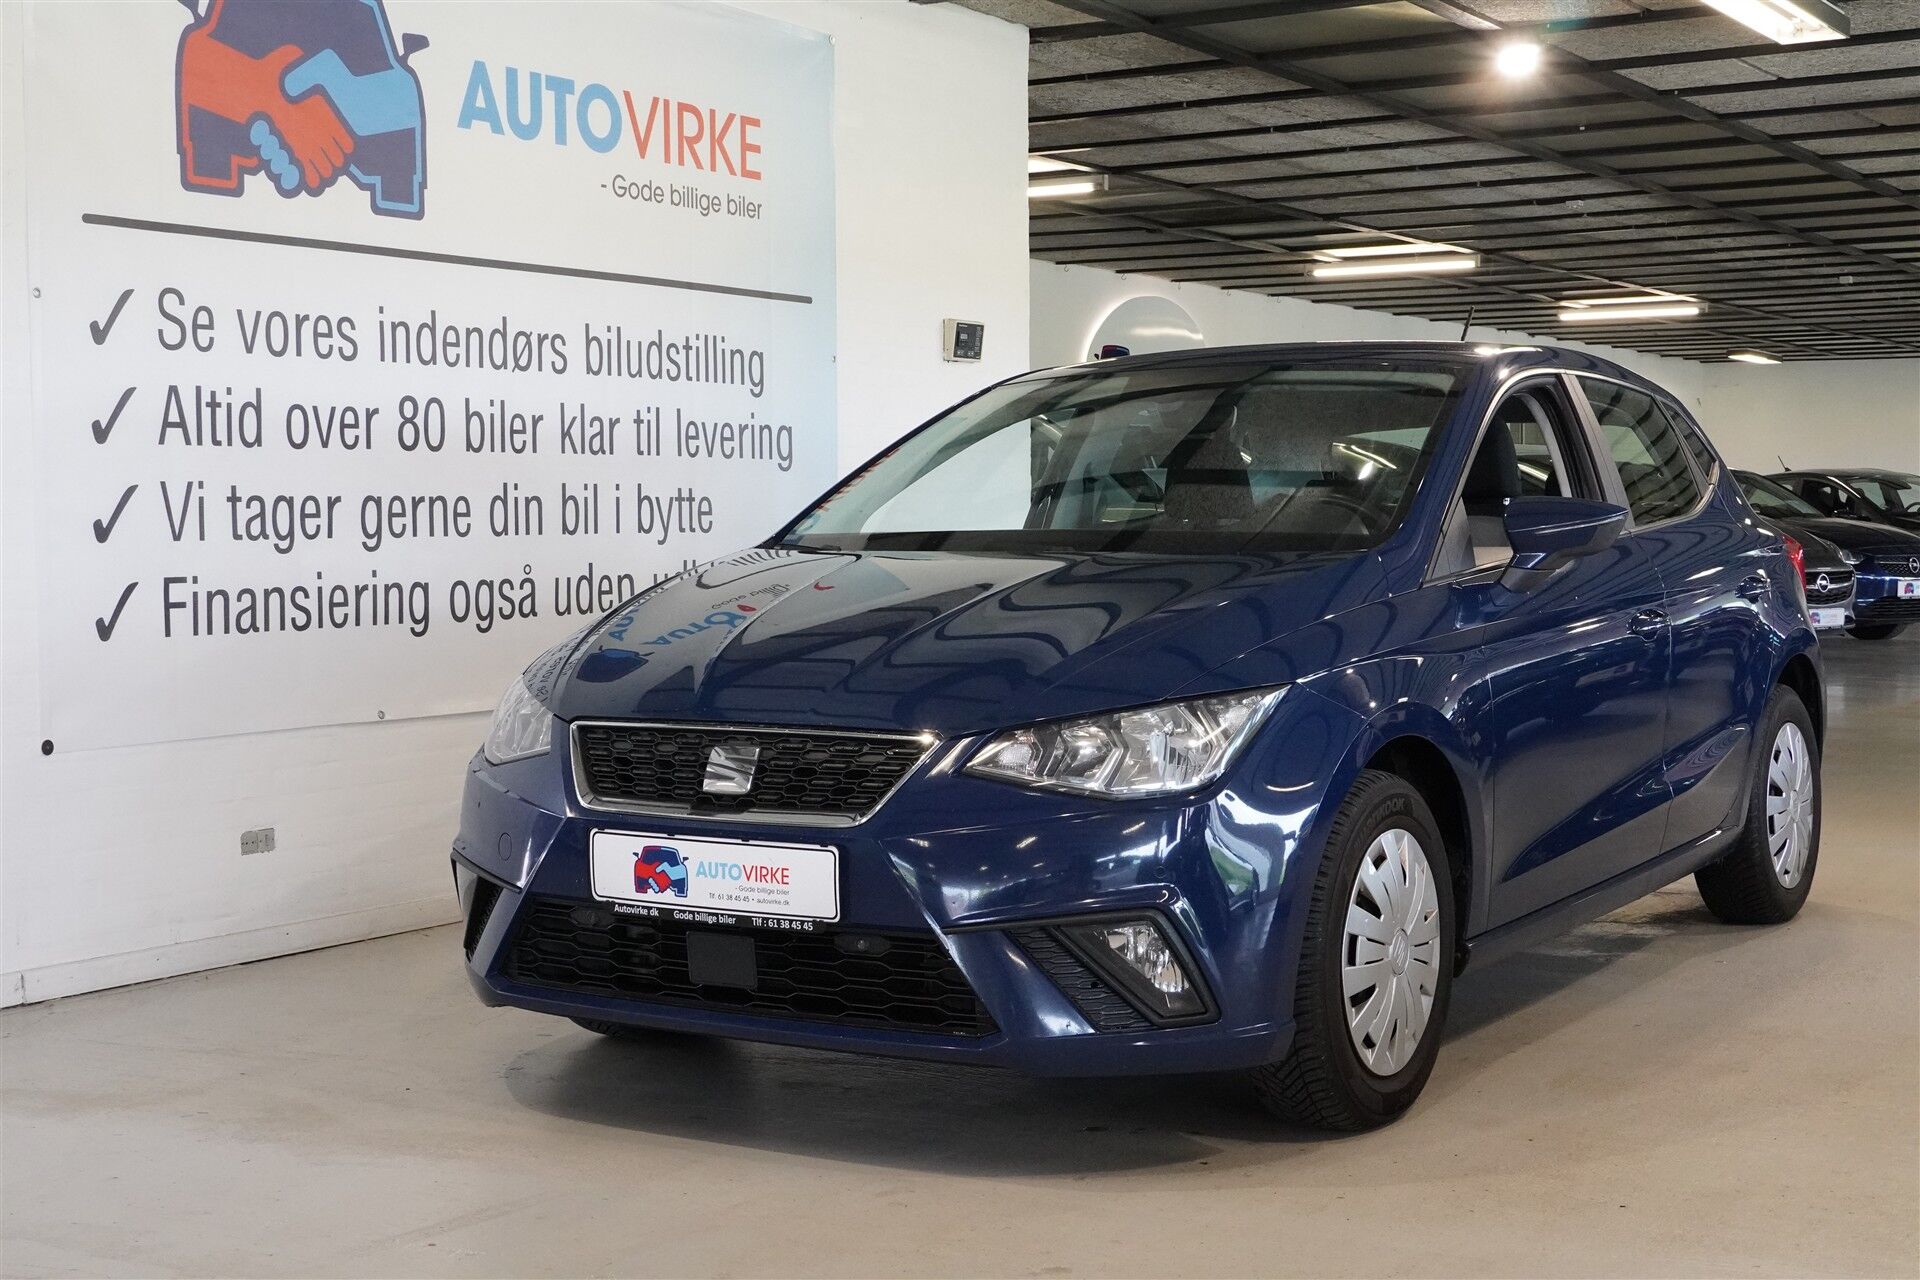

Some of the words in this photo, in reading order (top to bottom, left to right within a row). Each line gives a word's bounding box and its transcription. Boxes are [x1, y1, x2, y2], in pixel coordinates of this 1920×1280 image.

[458, 61, 762, 181] AUTOVIRKE
[612, 174, 665, 204] Gode
[670, 183, 722, 217] billige
[726, 193, 763, 220] biler
[157, 287, 215, 353] Se
[236, 308, 359, 362] vores
[378, 305, 568, 375] indendørs
[584, 322, 765, 399] biludstilling
[158, 384, 263, 449] Altid
[285, 403, 380, 451] over
[397, 394, 446, 453] 80
[464, 397, 544, 455] biler
[559, 402, 621, 456] klar
[632, 406, 661, 457] til
[676, 407, 793, 472] levering
[159, 480, 206, 542] Vi
[226, 484, 342, 555] tager
[360, 494, 472, 553] gerne
[489, 481, 543, 538] din
[561, 482, 599, 537] bil
[615, 483, 621, 534] i
[637, 482, 713, 546] bytte
[163, 569, 430, 638] Finansiering
[449, 563, 538, 634] også
[554, 562, 635, 617] uden
[695, 861, 789, 885] AUTOVIRKE
[726, 893, 733, 901] 38
[738, 885, 756, 893] Gode
[614, 904, 648, 915] Autovirke
[650, 907, 659, 916] dk
[673, 910, 693, 920] Gode
[694, 912, 717, 924] billige
[718, 914, 736, 925] biler
[768, 919, 778, 928] 61
[780, 920, 790, 929] 38
[791, 921, 802, 930] 45
[802, 922, 814, 931] 45
